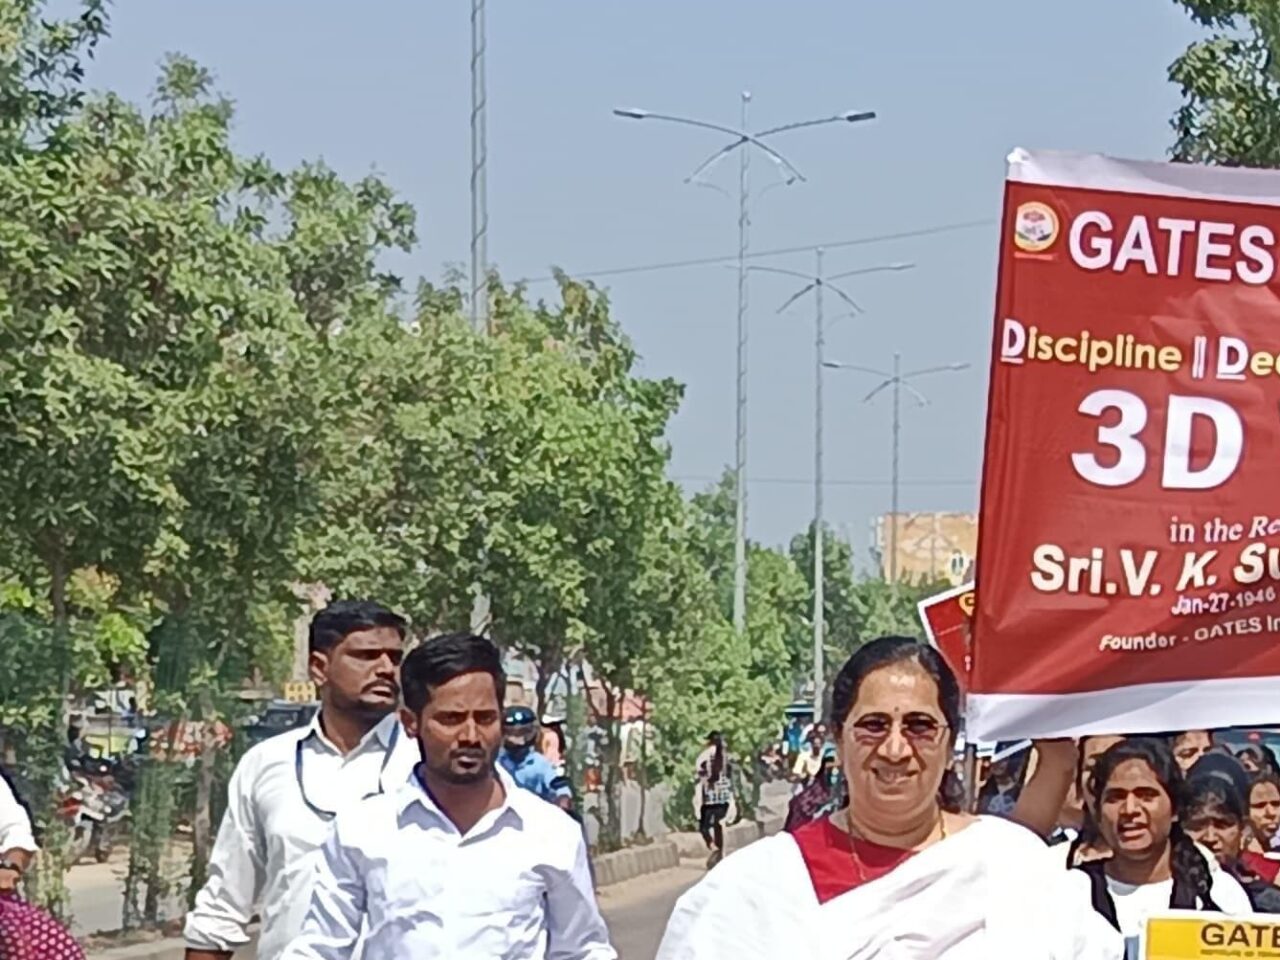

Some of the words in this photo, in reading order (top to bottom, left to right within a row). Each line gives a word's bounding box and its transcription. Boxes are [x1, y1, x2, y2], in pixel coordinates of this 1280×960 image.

[1069, 209, 1275, 285] GATES
[1001, 318, 1183, 372] Discipline
[1071, 389, 1244, 489] 3D
[1169, 516, 1195, 543] in
[1204, 517, 1244, 543] the
[1175, 550, 1219, 592] K.
[1099, 632, 1177, 651] Founder
